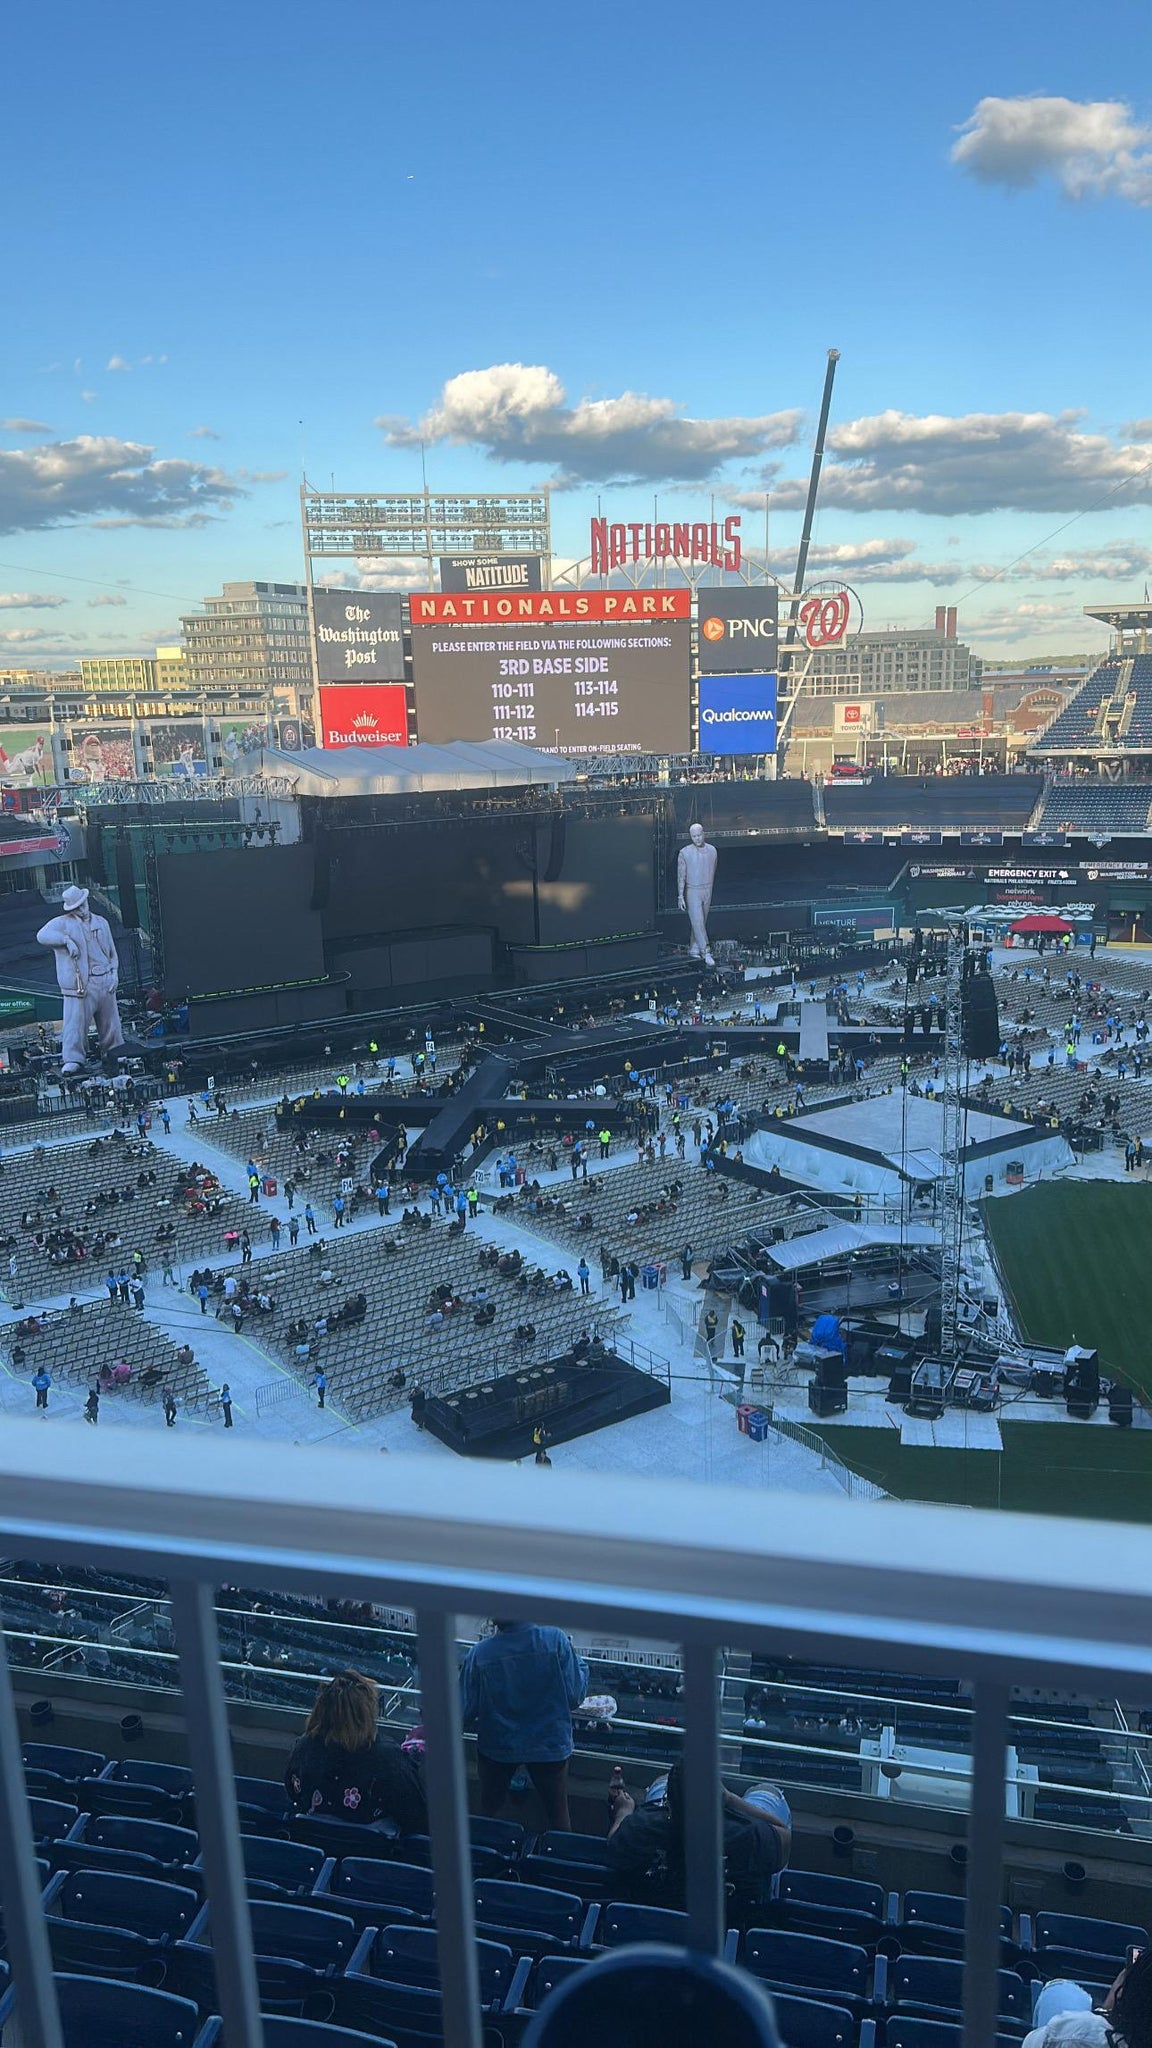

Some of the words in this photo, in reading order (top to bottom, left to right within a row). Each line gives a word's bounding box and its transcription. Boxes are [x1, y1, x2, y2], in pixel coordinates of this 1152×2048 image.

[591, 516, 741, 574] NATIONALS
[476, 558, 498, 566] SOME
[466, 564, 528, 587] NATITUDE
[345, 605, 371, 623] The
[421, 598, 589, 616] NATIONALS
[605, 596, 676, 613] PARK
[318, 623, 400, 645] Washington
[727, 618, 774, 638] PNC
[432, 641, 466, 652] PLEASE
[468, 641, 495, 652] ENTER
[496, 641, 514, 651] THE
[516, 640, 540, 650] FIELD
[540, 640, 557, 650] VIA
[558, 639, 575, 649] THE
[576, 638, 626, 649] FOLLOWING
[628, 637, 672, 648] SECTIONS:
[345, 649, 377, 668] Post
[499, 658, 530, 676] 3RD
[533, 657, 572, 675] BASE
[575, 657, 608, 673] SIDE
[492, 682, 534, 698] 110-111
[574, 680, 618, 696] 113-114
[493, 705, 535, 720] 111-112
[575, 702, 618, 717] 114-115
[702, 709, 773, 724] Qualcomm
[328, 730, 402, 744] Budweiser
[493, 726, 536, 740] 112-113
[569, 745, 587, 753] ENTER
[588, 744, 617, 752] ON-FIELD
[617, 743, 642, 751] SEATING
[988, 869, 1037, 877] EMERGENCY
[1038, 870, 1057, 878] EXIT
